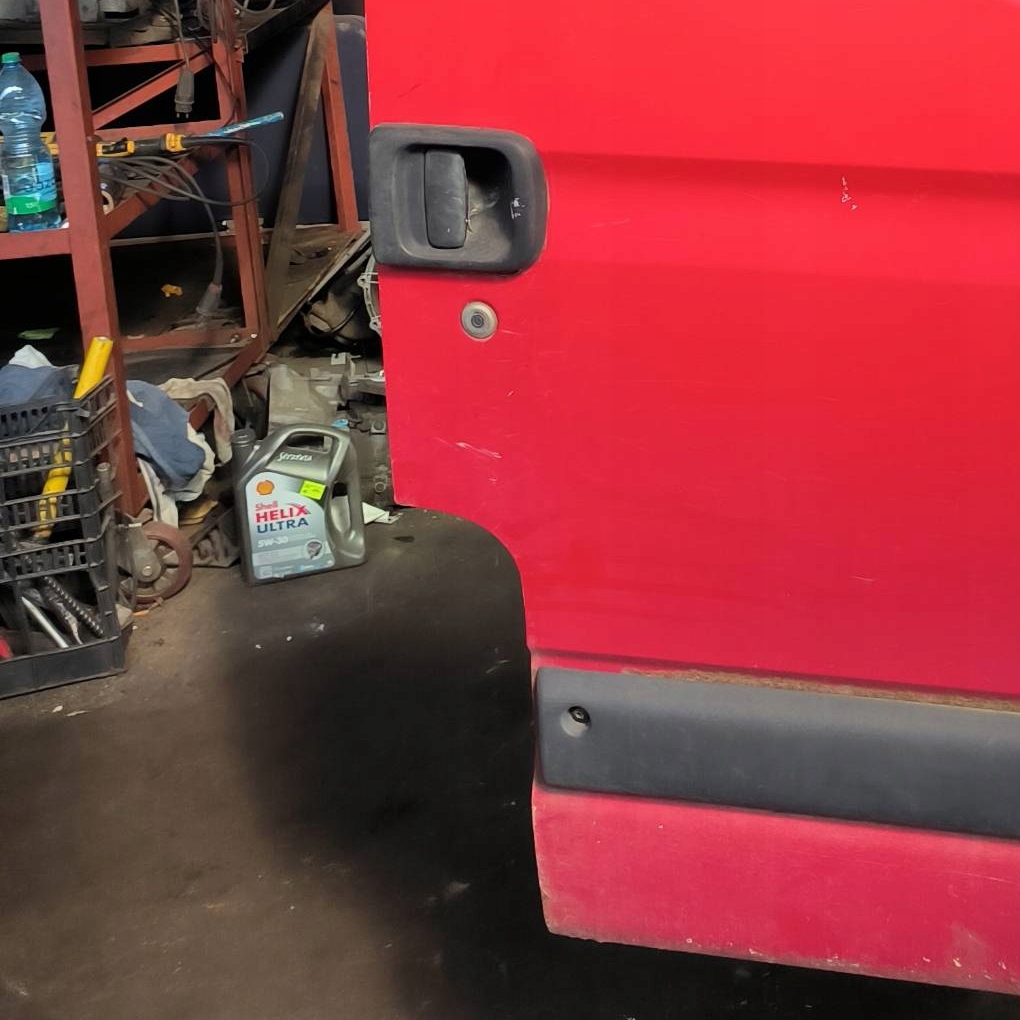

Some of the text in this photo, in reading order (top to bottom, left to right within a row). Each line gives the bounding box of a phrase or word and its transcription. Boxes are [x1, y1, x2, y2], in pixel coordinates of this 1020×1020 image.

[255, 500, 279, 511] Shell
[255, 504, 311, 523] HELIX
[256, 517, 310, 534] ULTRA
